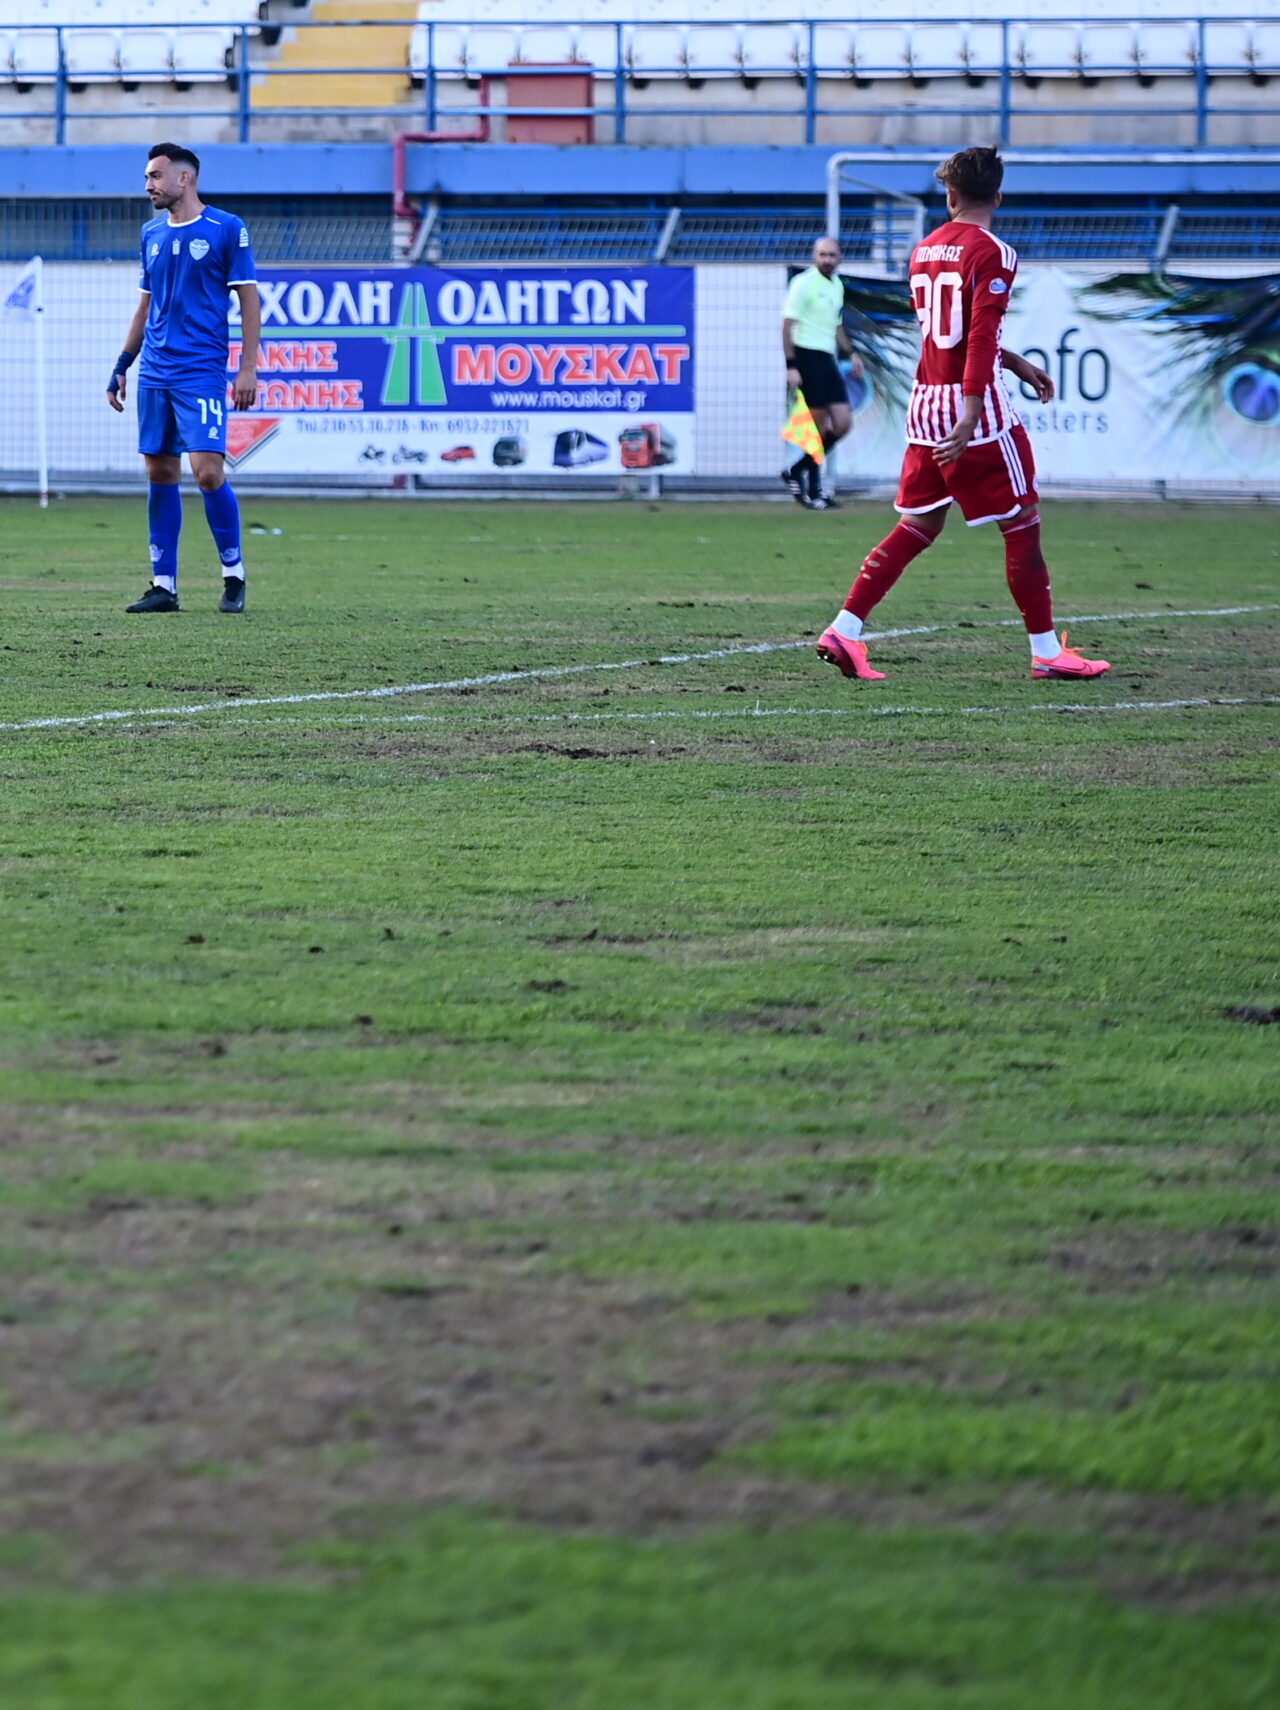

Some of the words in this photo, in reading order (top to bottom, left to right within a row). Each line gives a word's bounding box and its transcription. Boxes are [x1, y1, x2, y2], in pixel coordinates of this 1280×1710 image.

[437, 279, 649, 326] ΟΔΗΓΩΝ
[451, 342, 691, 386] ΜΟΥΣΚΑΤ
[1008, 327, 1111, 402] afo
[197, 398, 223, 426] 14
[491, 388, 647, 412] www.mouskat.gr
[1019, 408, 1109, 433] asters
